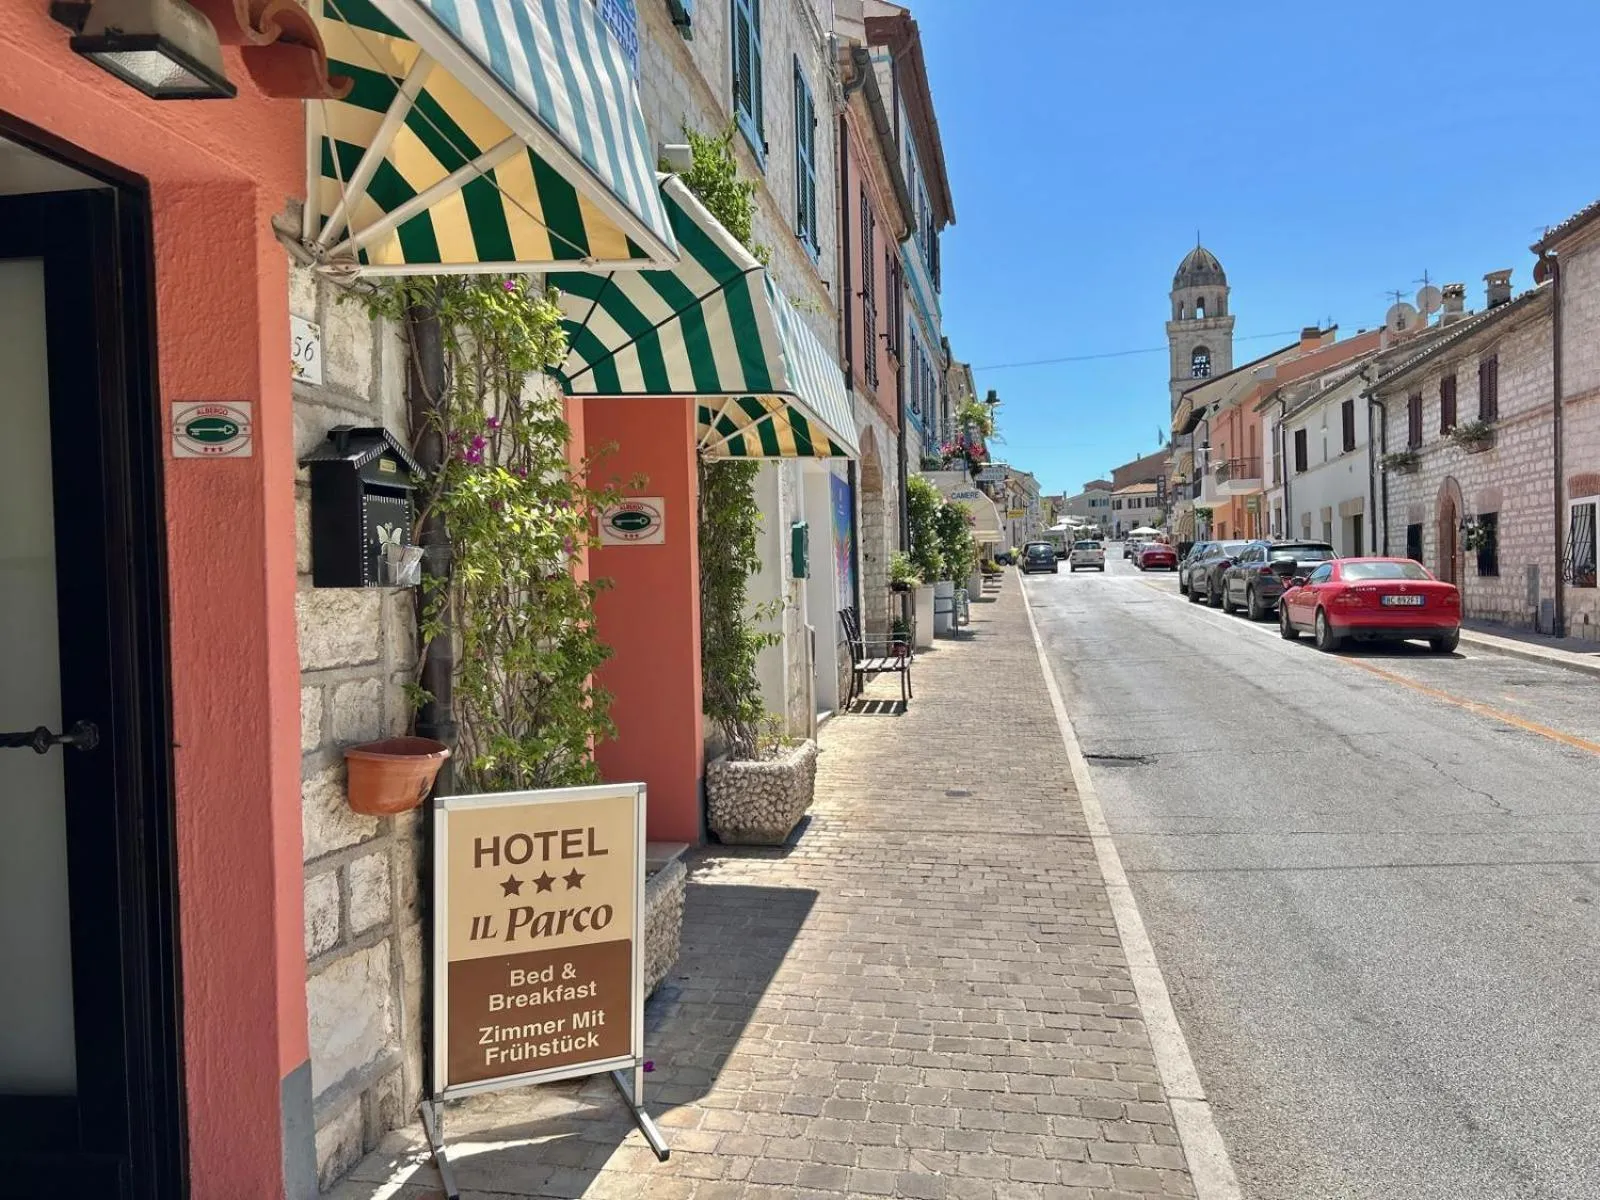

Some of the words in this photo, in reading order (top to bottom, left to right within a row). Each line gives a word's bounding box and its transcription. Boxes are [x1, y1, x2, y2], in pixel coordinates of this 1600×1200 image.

[293, 336, 314, 362] 56
[196, 406, 229, 416] ALBERGO
[951, 491, 979, 499] CAMERE
[473, 827, 609, 868] HOTEL
[469, 914, 498, 941] IL
[504, 903, 613, 942] Parco
[510, 964, 553, 987] Bed
[561, 962, 577, 980] &
[489, 981, 597, 1012] Breakfast
[478, 1017, 566, 1045] Zimmer
[572, 1008, 605, 1030] Mit
[485, 1032, 599, 1065] Frühstück
